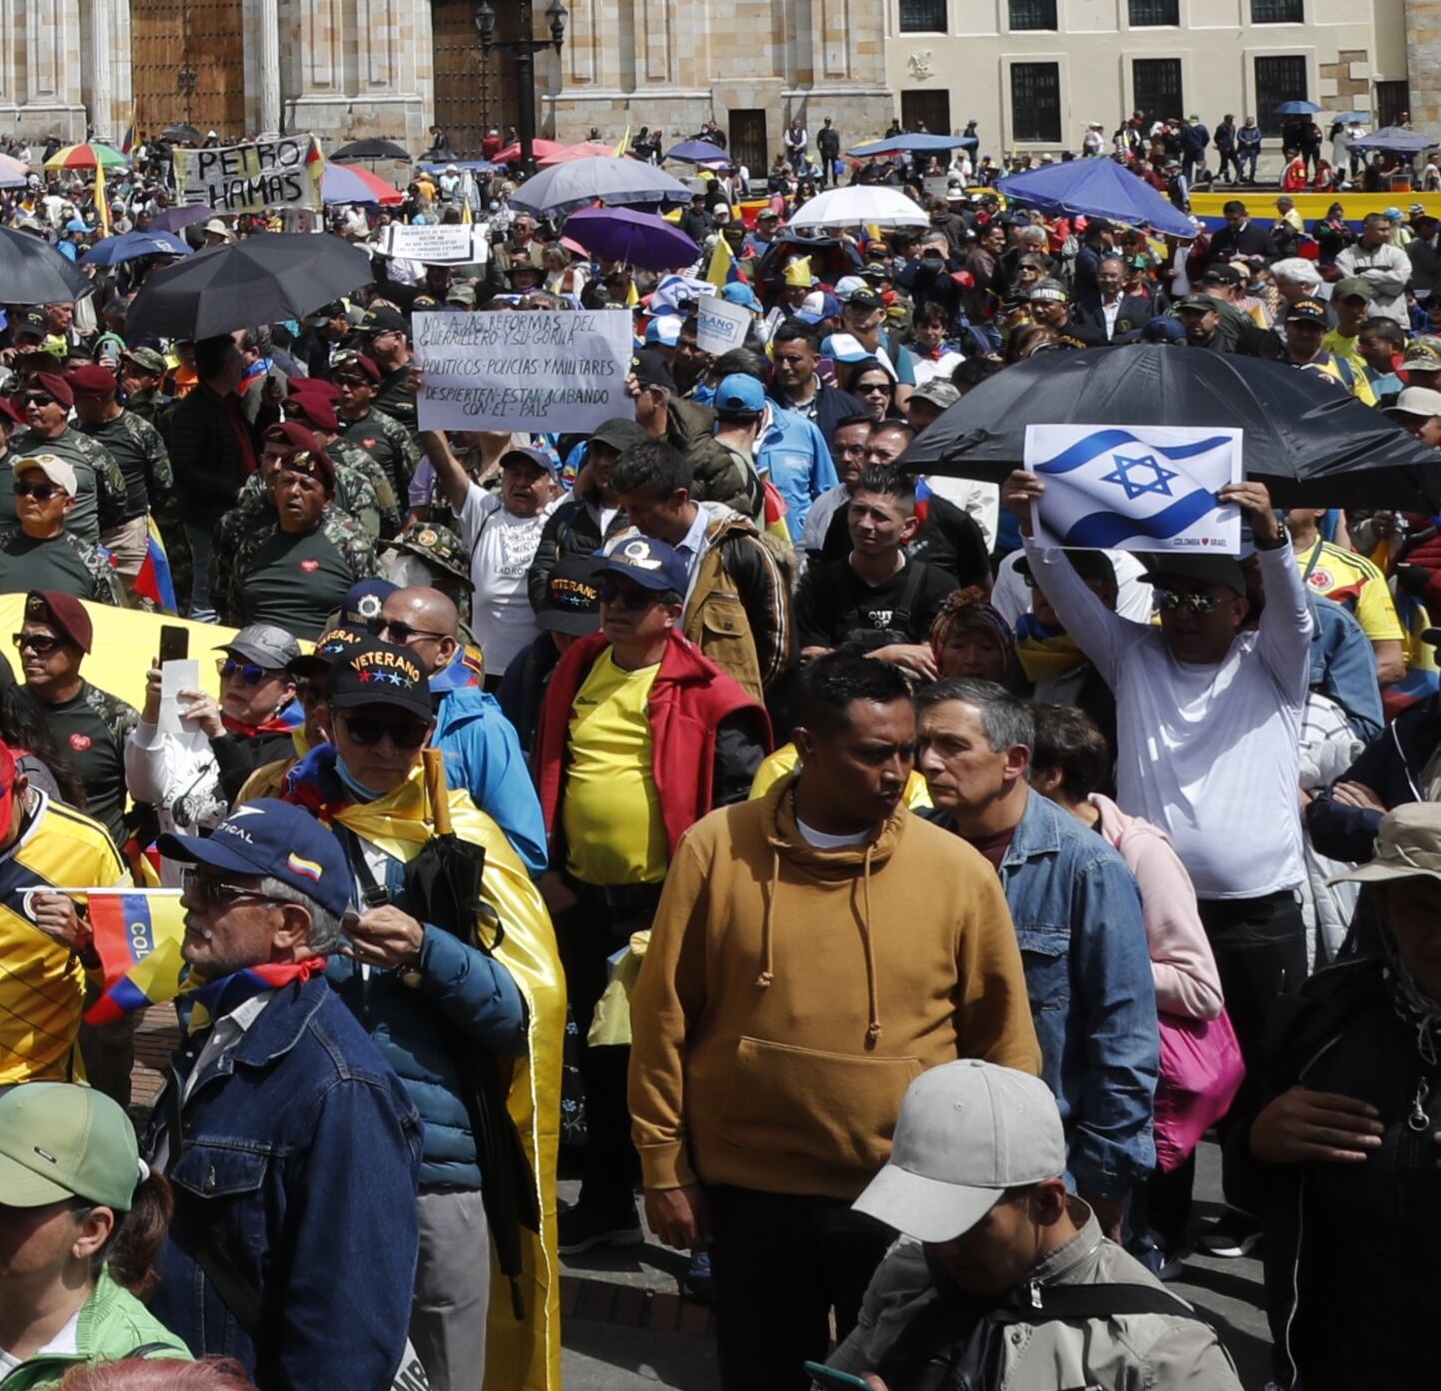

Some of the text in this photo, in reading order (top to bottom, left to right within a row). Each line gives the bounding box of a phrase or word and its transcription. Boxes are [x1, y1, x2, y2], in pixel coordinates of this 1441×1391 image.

[197, 141, 301, 180] PETRO
[209, 172, 303, 210] HAMAS
[489, 314, 561, 332] REFORMAS
[572, 314, 597, 334] DEL
[868, 609, 894, 620] OUT
[349, 651, 421, 683] VETERANO
